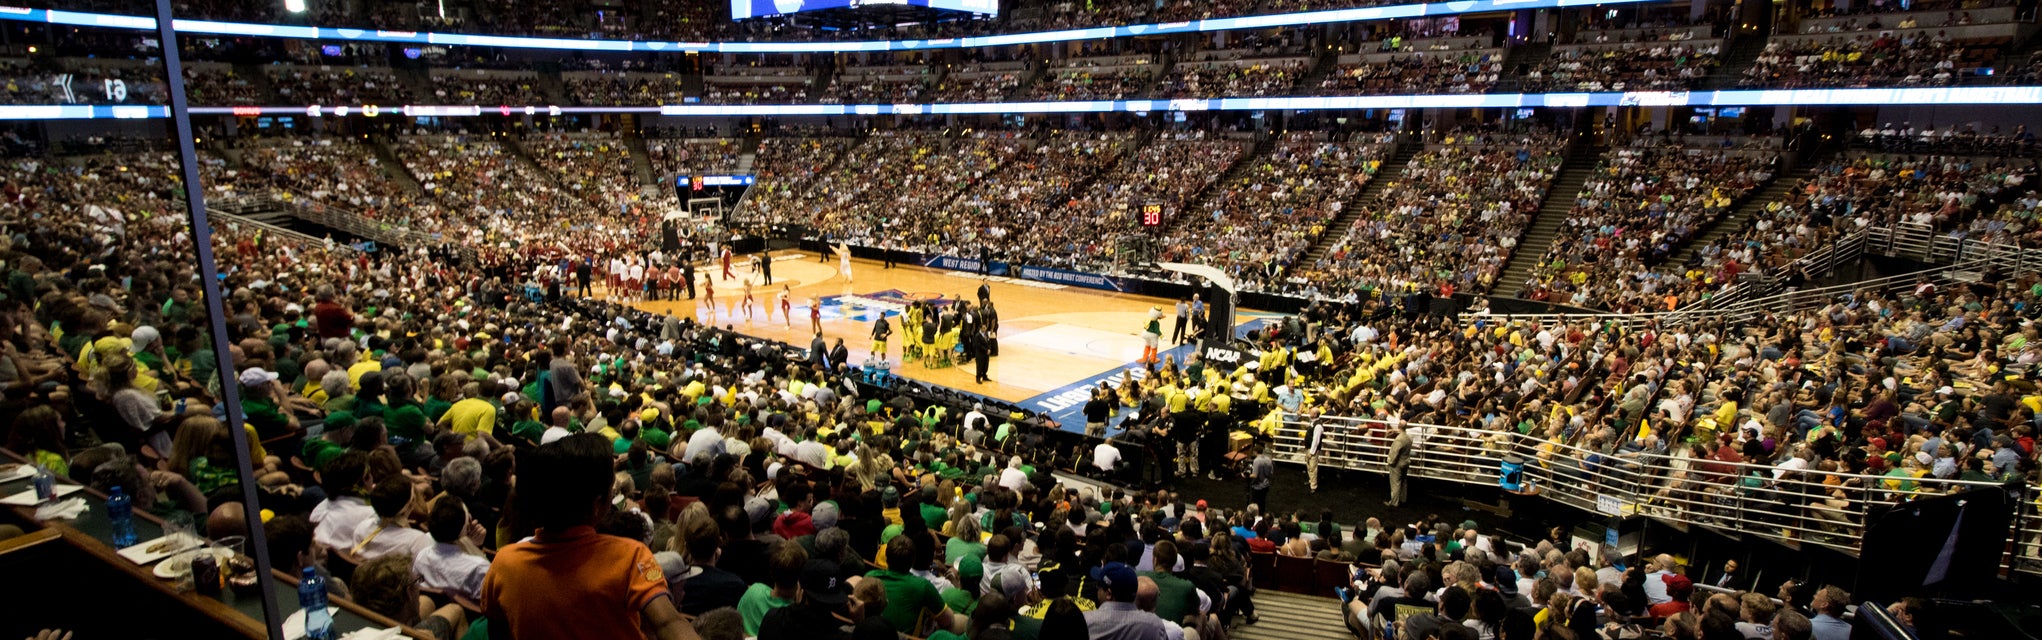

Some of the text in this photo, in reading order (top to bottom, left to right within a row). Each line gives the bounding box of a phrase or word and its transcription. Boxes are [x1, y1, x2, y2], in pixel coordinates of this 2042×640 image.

[1144, 212, 1159, 225] 30
[942, 258, 960, 269] WEST
[1063, 273, 1075, 281] WEST
[1075, 274, 1104, 286] CONFERENCE
[1205, 347, 1241, 363] NCAA
